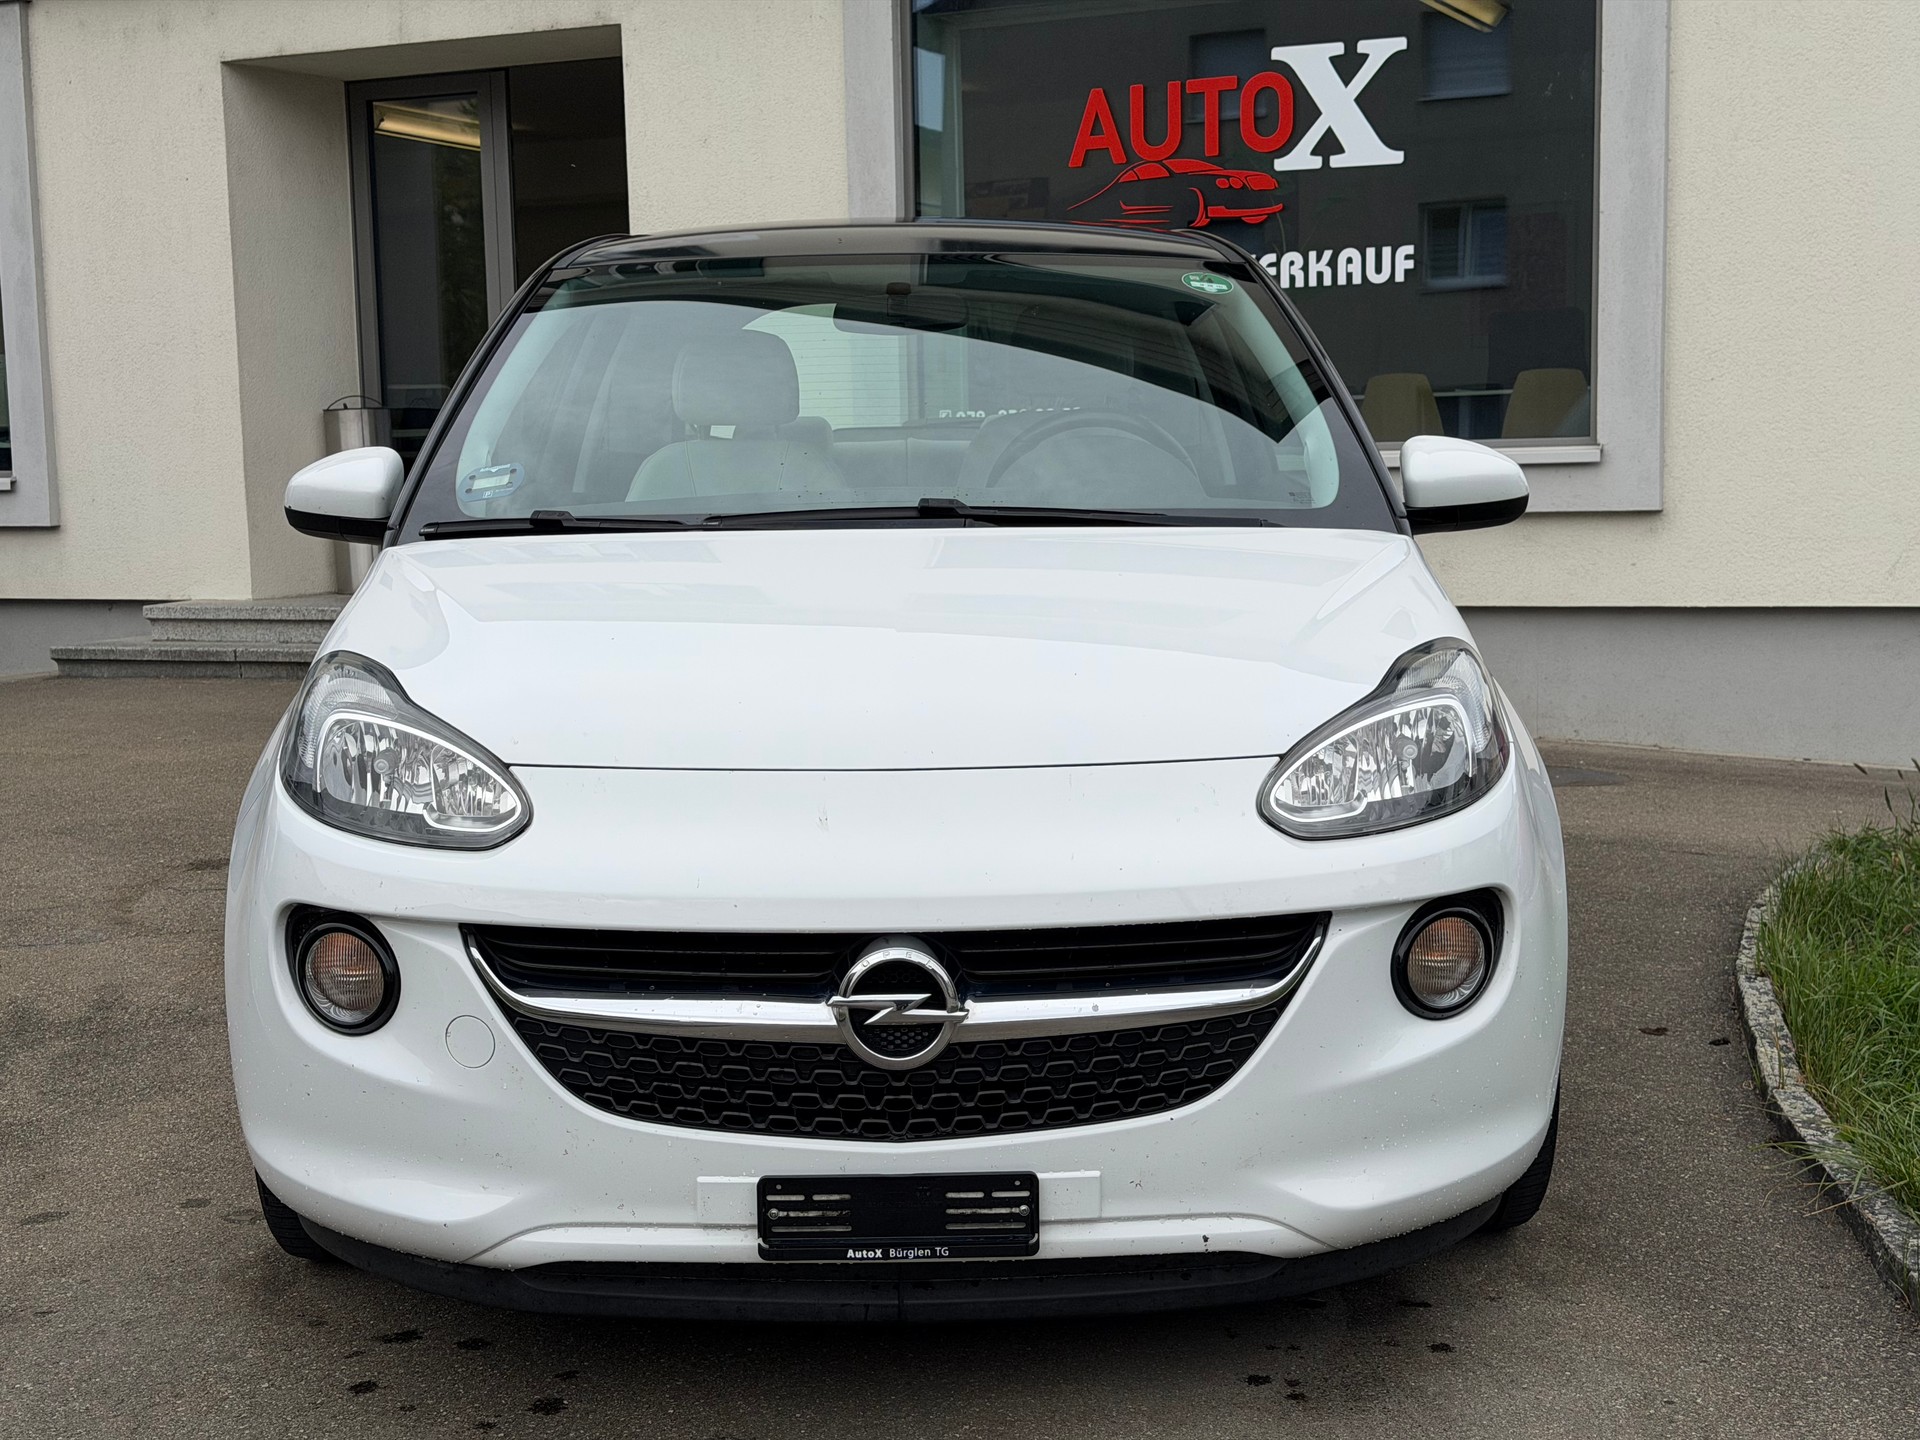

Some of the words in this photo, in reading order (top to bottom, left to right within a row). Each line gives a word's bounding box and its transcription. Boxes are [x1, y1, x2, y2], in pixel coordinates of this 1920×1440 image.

[846, 1248, 883, 1258] AutoX
[889, 1247, 931, 1259] Bürglen
[935, 1247, 950, 1256] TG
